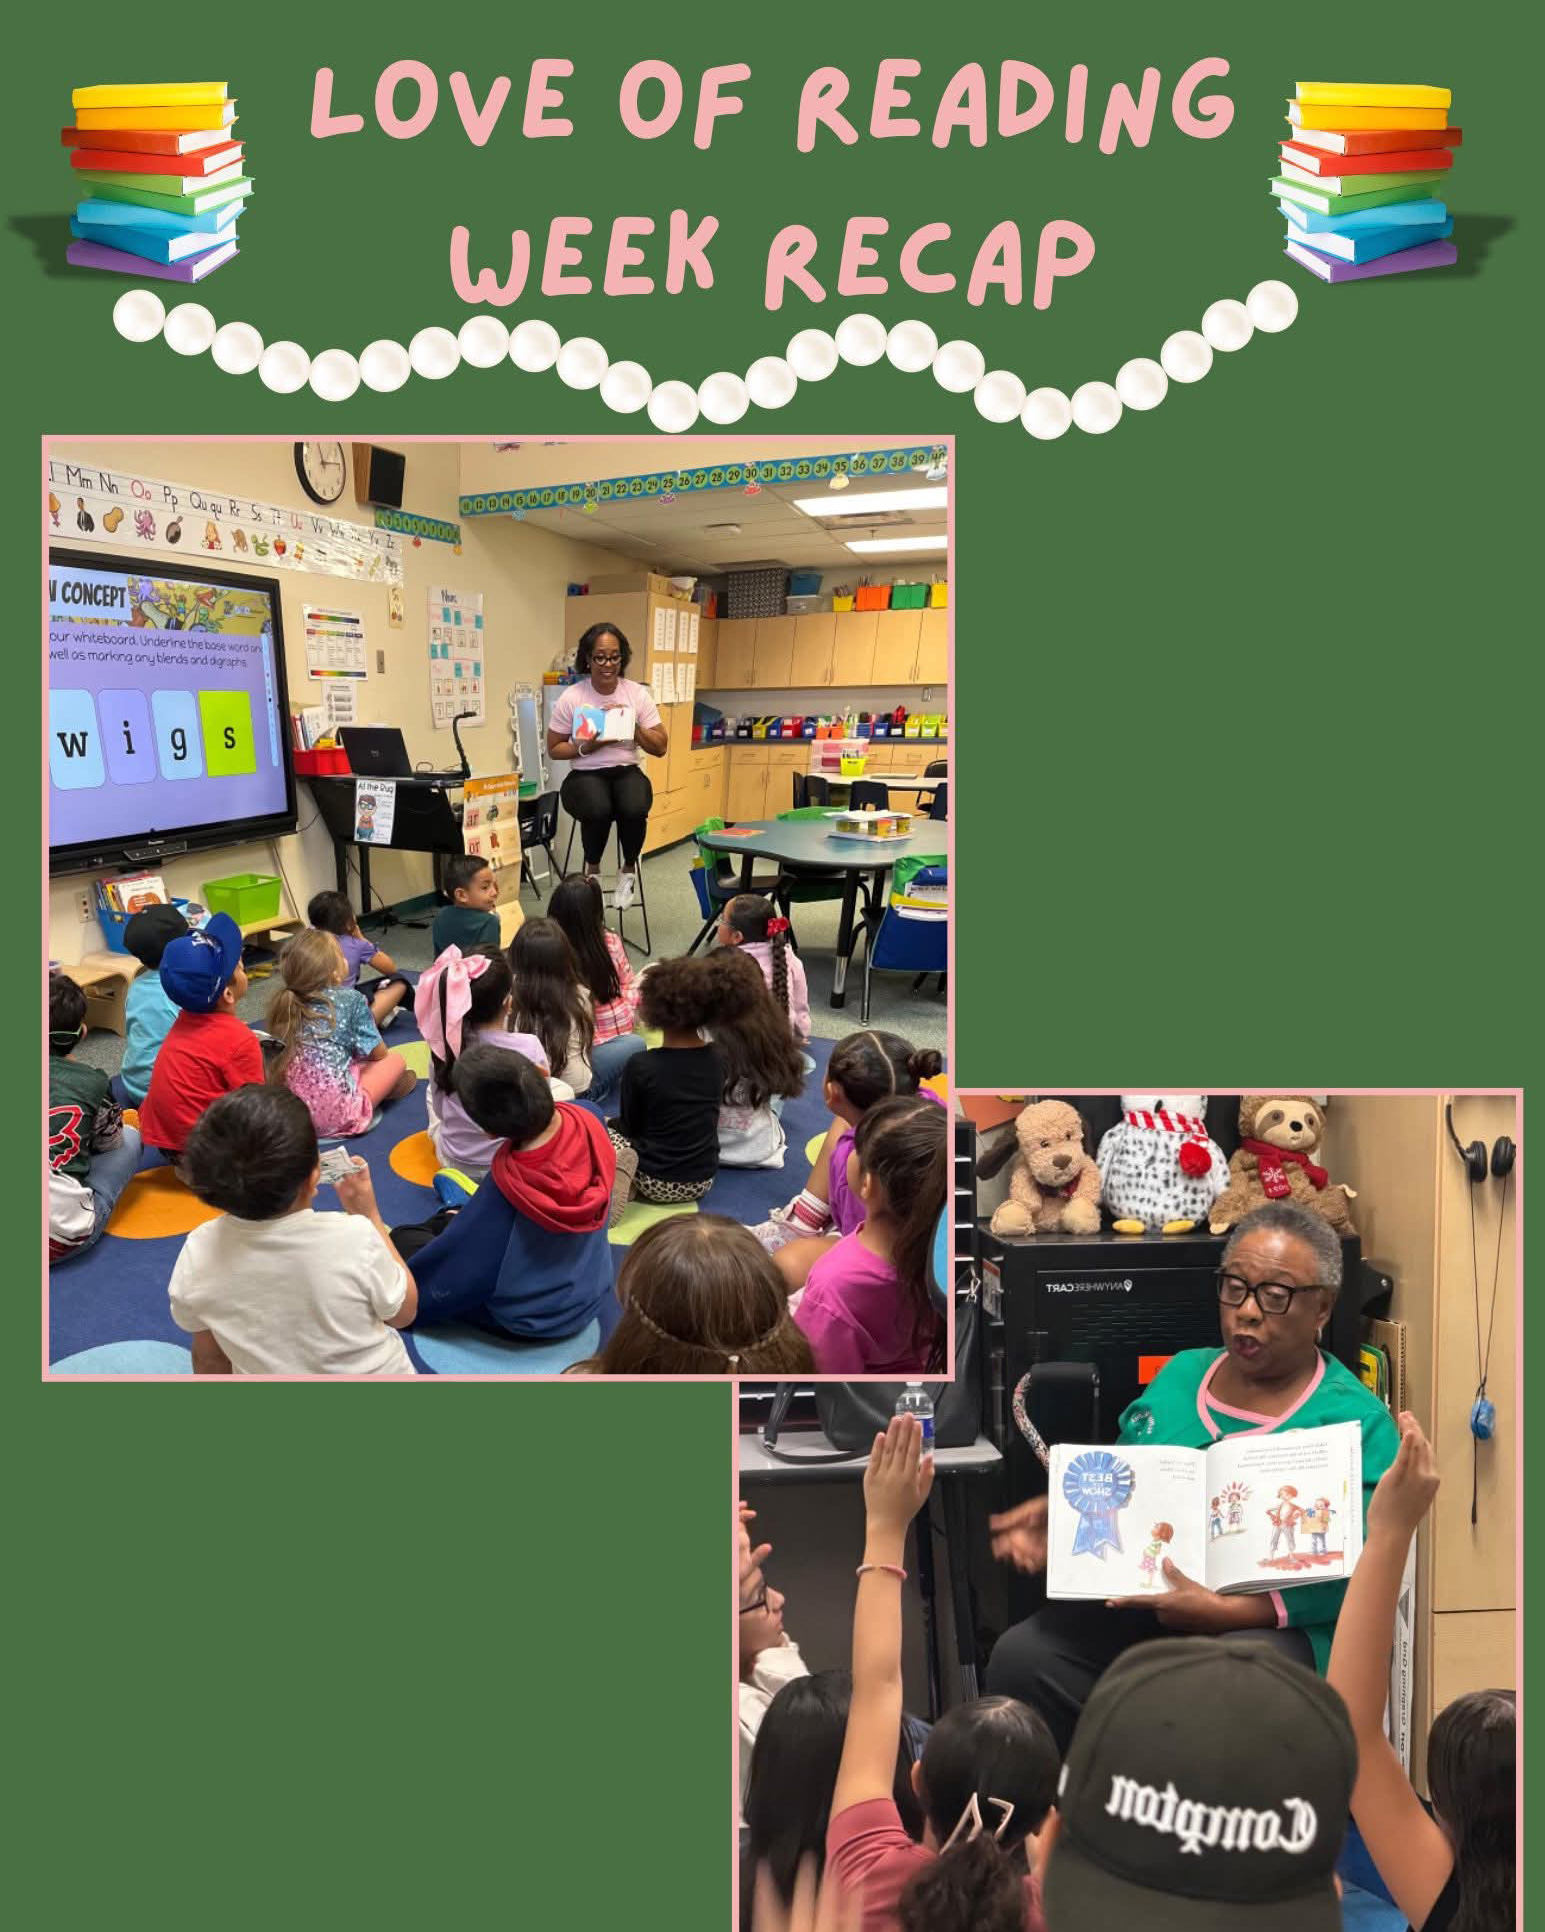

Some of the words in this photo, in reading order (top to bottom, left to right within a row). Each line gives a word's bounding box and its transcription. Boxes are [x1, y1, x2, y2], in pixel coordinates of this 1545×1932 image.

[66, 465, 92, 489] Mm
[100, 473, 118, 494] Nn
[131, 479, 151, 500] Oo
[163, 486, 178, 513] Pp
[572, 489, 580, 499] 19
[586, 487, 595, 497] 20
[602, 485, 610, 495] 21
[616, 484, 626, 493] 22
[632, 482, 642, 491] 23
[647, 480, 657, 490] 24
[663, 478, 673, 488] 25
[679, 476, 690, 486] 26
[695, 474, 705, 484] 27
[711, 472, 722, 482] 28
[729, 470, 740, 480] 29
[745, 468, 757, 478] 30
[764, 467, 773, 477] 31
[780, 466, 791, 476] 32
[799, 464, 810, 474] 33
[815, 462, 828, 473] 34
[834, 461, 846, 471] 35
[853, 460, 865, 470] 36
[872, 458, 885, 468] 37
[890, 456, 904, 466] 38
[911, 454, 925, 464] 39
[61, 581, 126, 608] CONCEPT
[72, 651, 86, 661] as
[88, 652, 133, 665] marking
[135, 654, 155, 666] any
[156, 653, 188, 664] blends
[190, 655, 207, 666] and
[140, 634, 186, 649] Underline
[187, 638, 203, 649] the
[205, 640, 226, 651] base
[229, 643, 249, 653] word
[57, 732, 88, 758] w
[123, 720, 136, 754] i
[170, 728, 187, 760] g
[223, 727, 236, 749] s
